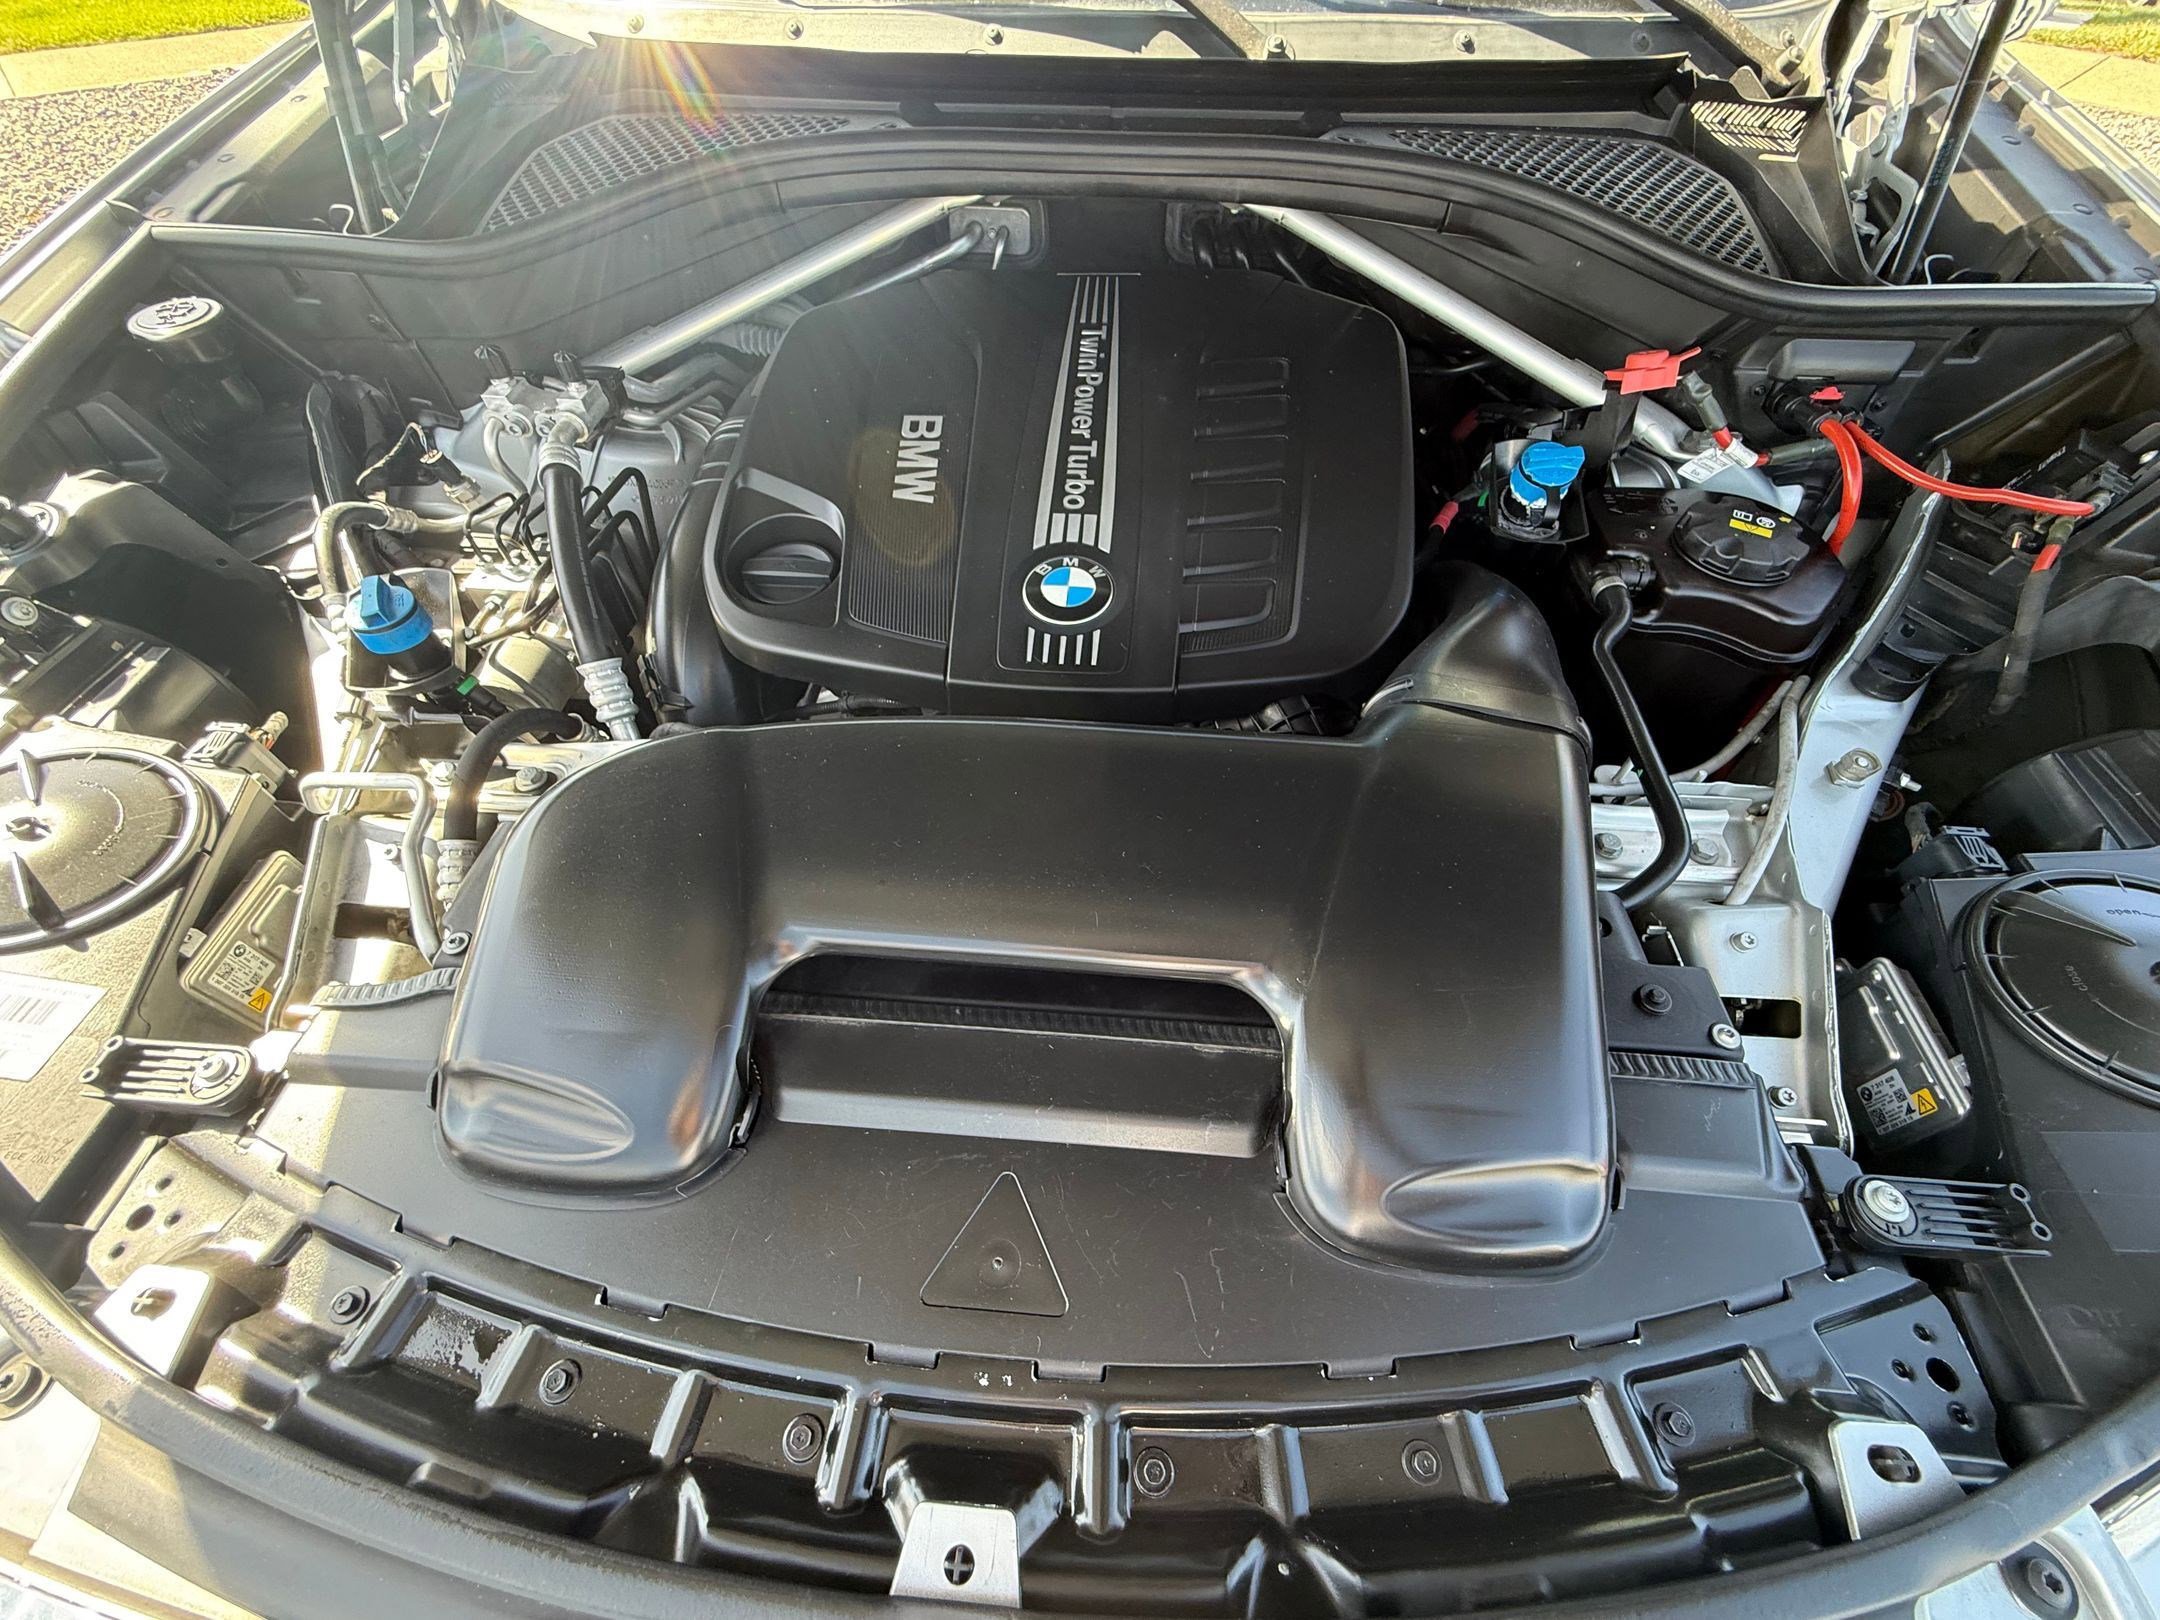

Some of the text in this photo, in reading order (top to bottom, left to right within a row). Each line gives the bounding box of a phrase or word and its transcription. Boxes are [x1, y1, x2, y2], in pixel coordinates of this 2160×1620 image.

[1062, 325, 1108, 511] TwinPower Turbo
[892, 414, 944, 504] BMW
[1034, 557, 1107, 579] BMW
[2065, 965, 2088, 991] close
[3, 1150, 61, 1165] ECE ONLY
